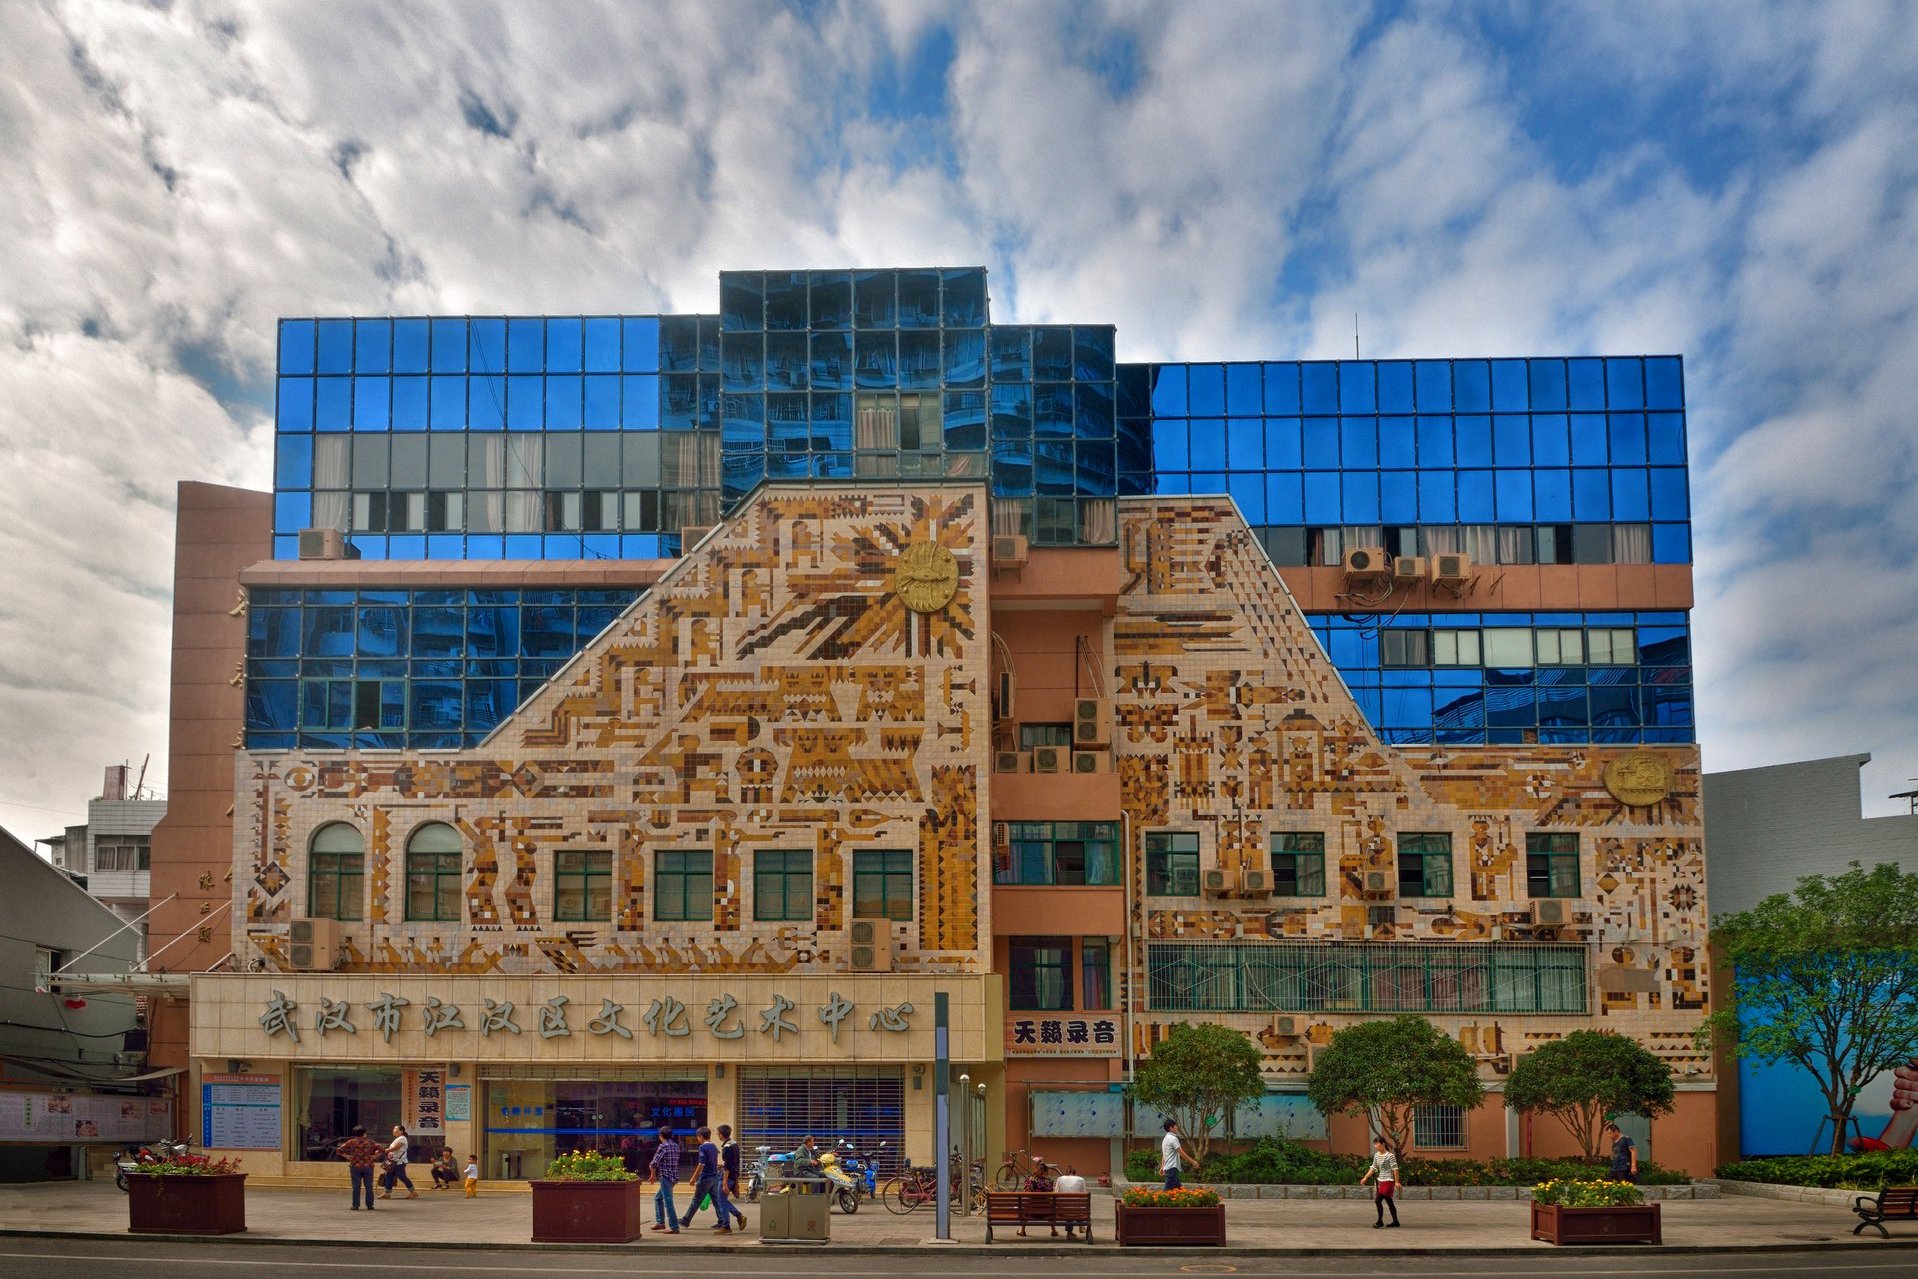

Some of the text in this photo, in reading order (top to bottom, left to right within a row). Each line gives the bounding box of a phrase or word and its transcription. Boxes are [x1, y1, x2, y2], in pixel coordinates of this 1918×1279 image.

[258, 990, 914, 1043] 武汉市江汉区文化艺术中心
[1014, 1020, 1115, 1043] 天籁录音
[418, 1071, 440, 1128] 天籁录音
